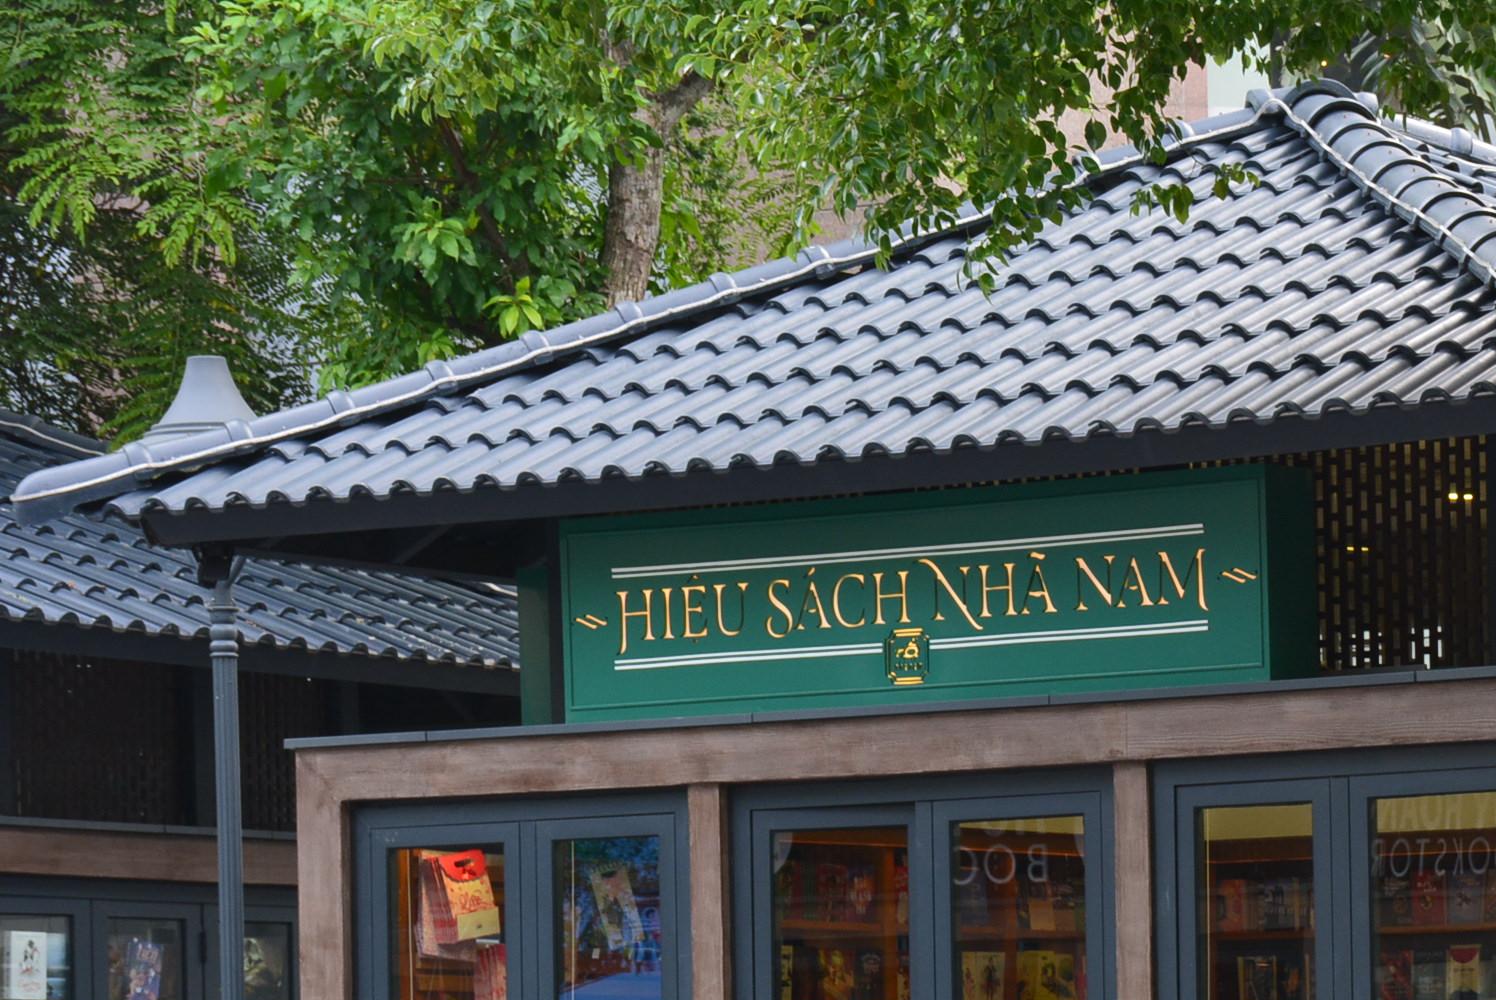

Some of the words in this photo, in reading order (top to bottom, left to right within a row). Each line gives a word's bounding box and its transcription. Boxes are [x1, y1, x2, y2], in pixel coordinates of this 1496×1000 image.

[765, 567, 912, 639] SÁCH
[917, 551, 1058, 631] NHÃ
[1074, 547, 1210, 612] NAM
